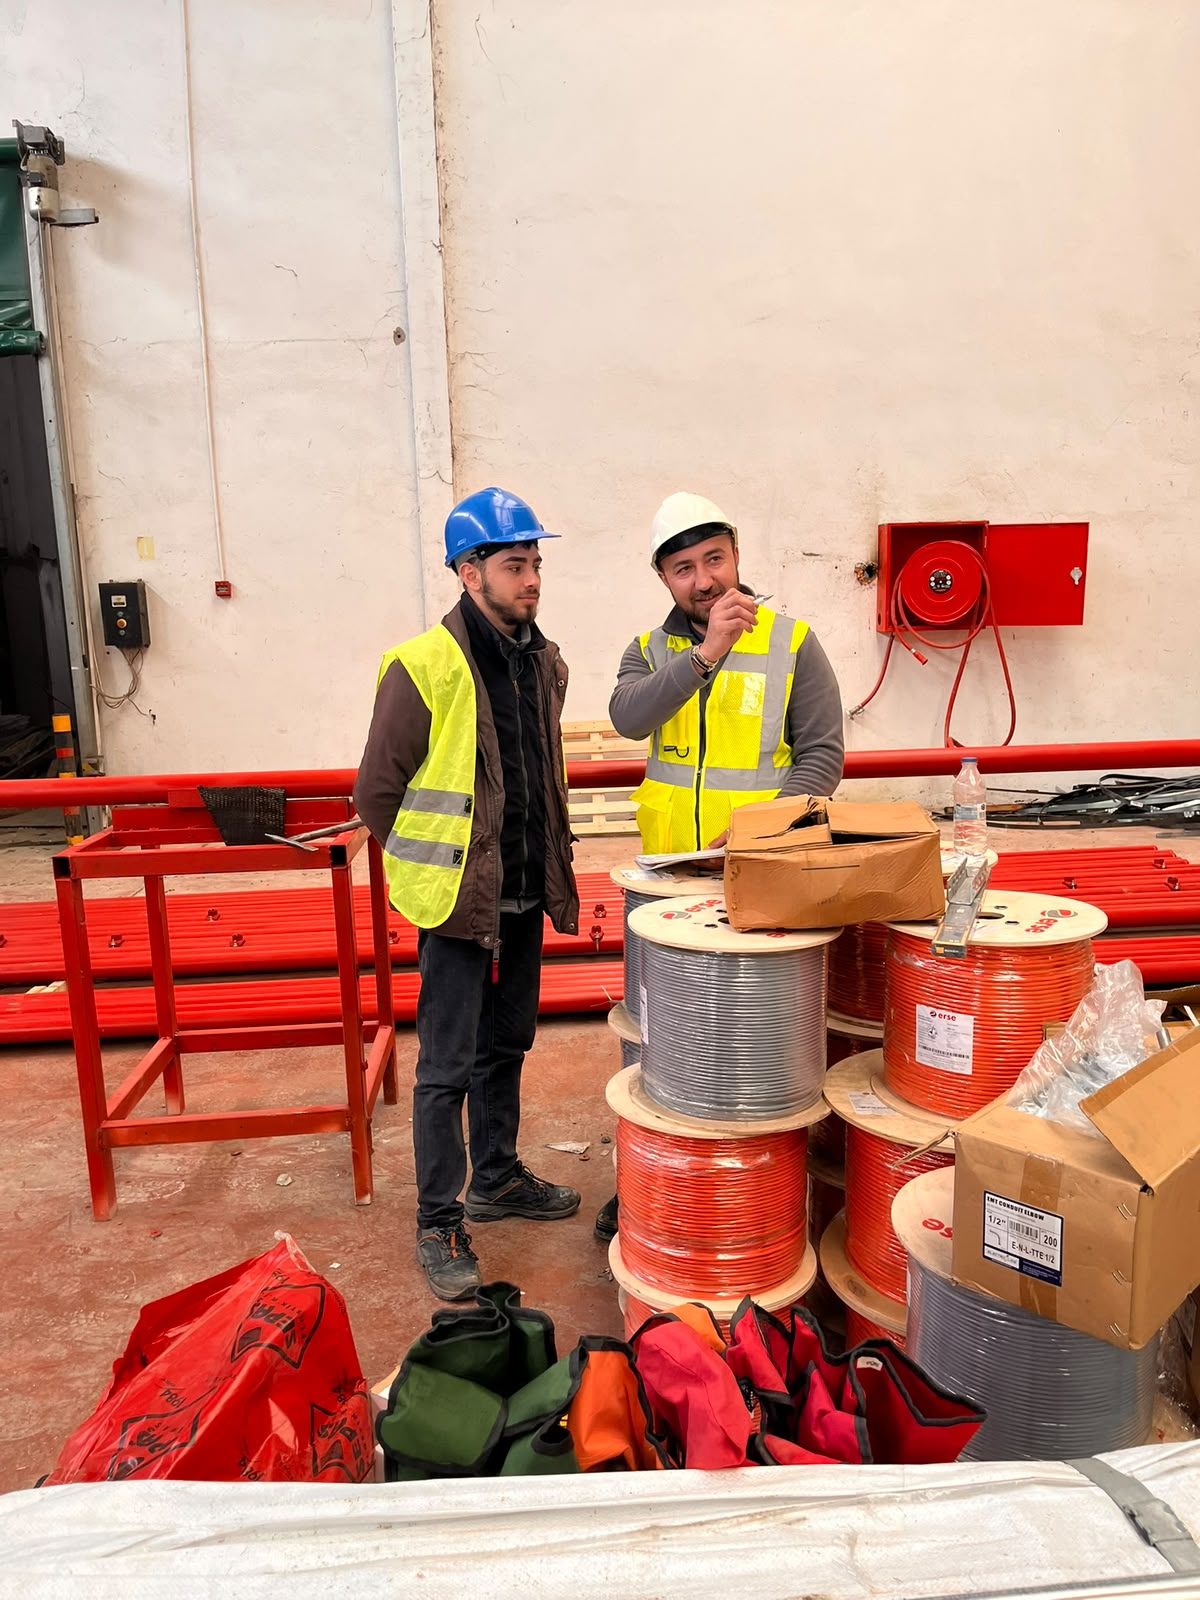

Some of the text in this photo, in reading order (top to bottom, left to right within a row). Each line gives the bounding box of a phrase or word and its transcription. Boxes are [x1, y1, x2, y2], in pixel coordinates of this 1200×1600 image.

[684, 899, 723, 912] erse
[1025, 918, 1058, 933] erse
[938, 1013, 957, 1021] erse
[999, 1200, 1023, 1213] CONDUIT
[1024, 1210, 1045, 1221] ELBOW
[1043, 1234, 1058, 1247] 200
[160, 1389, 187, 1408] 1984
